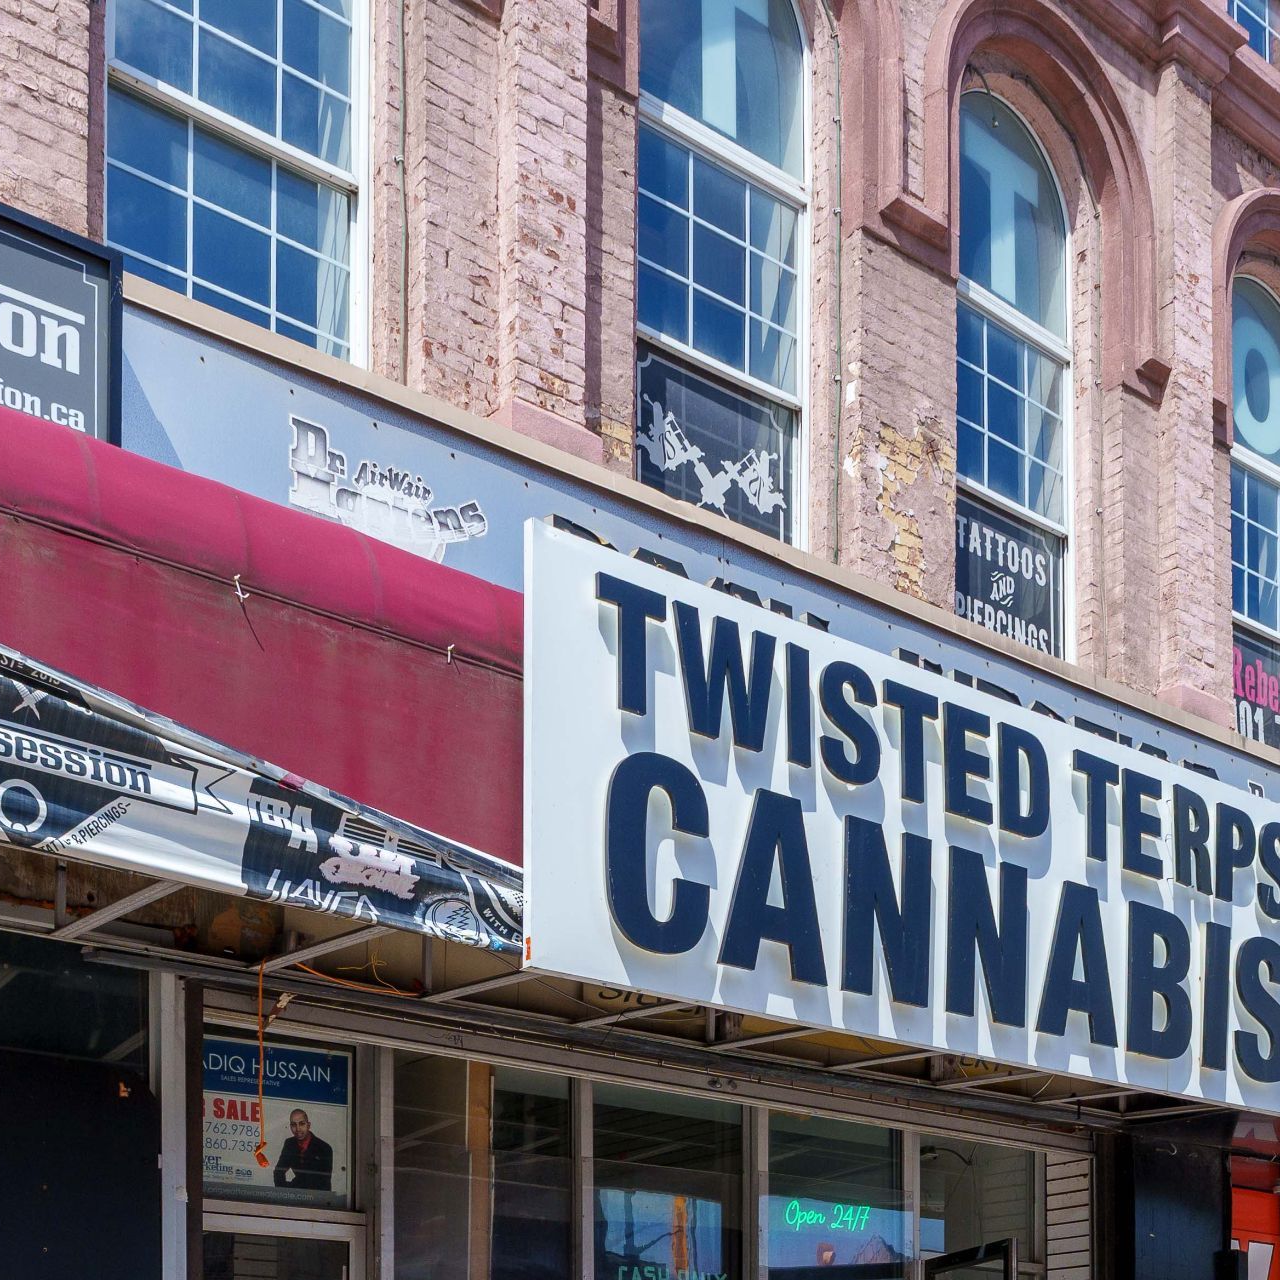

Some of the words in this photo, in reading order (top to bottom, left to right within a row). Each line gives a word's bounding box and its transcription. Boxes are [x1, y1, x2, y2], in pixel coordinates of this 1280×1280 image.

[354, 461, 432, 502] AirWair
[956, 514, 1047, 587] TATTOOS
[990, 575, 1015, 601] AND
[594, 570, 1052, 839] TWISTED
[203, 1053, 246, 1075] DIQ
[252, 1058, 331, 1083] HUSSAIN
[213, 1098, 260, 1123] SALE
[784, 1199, 826, 1231] Open
[830, 1204, 871, 1232] 24/7
